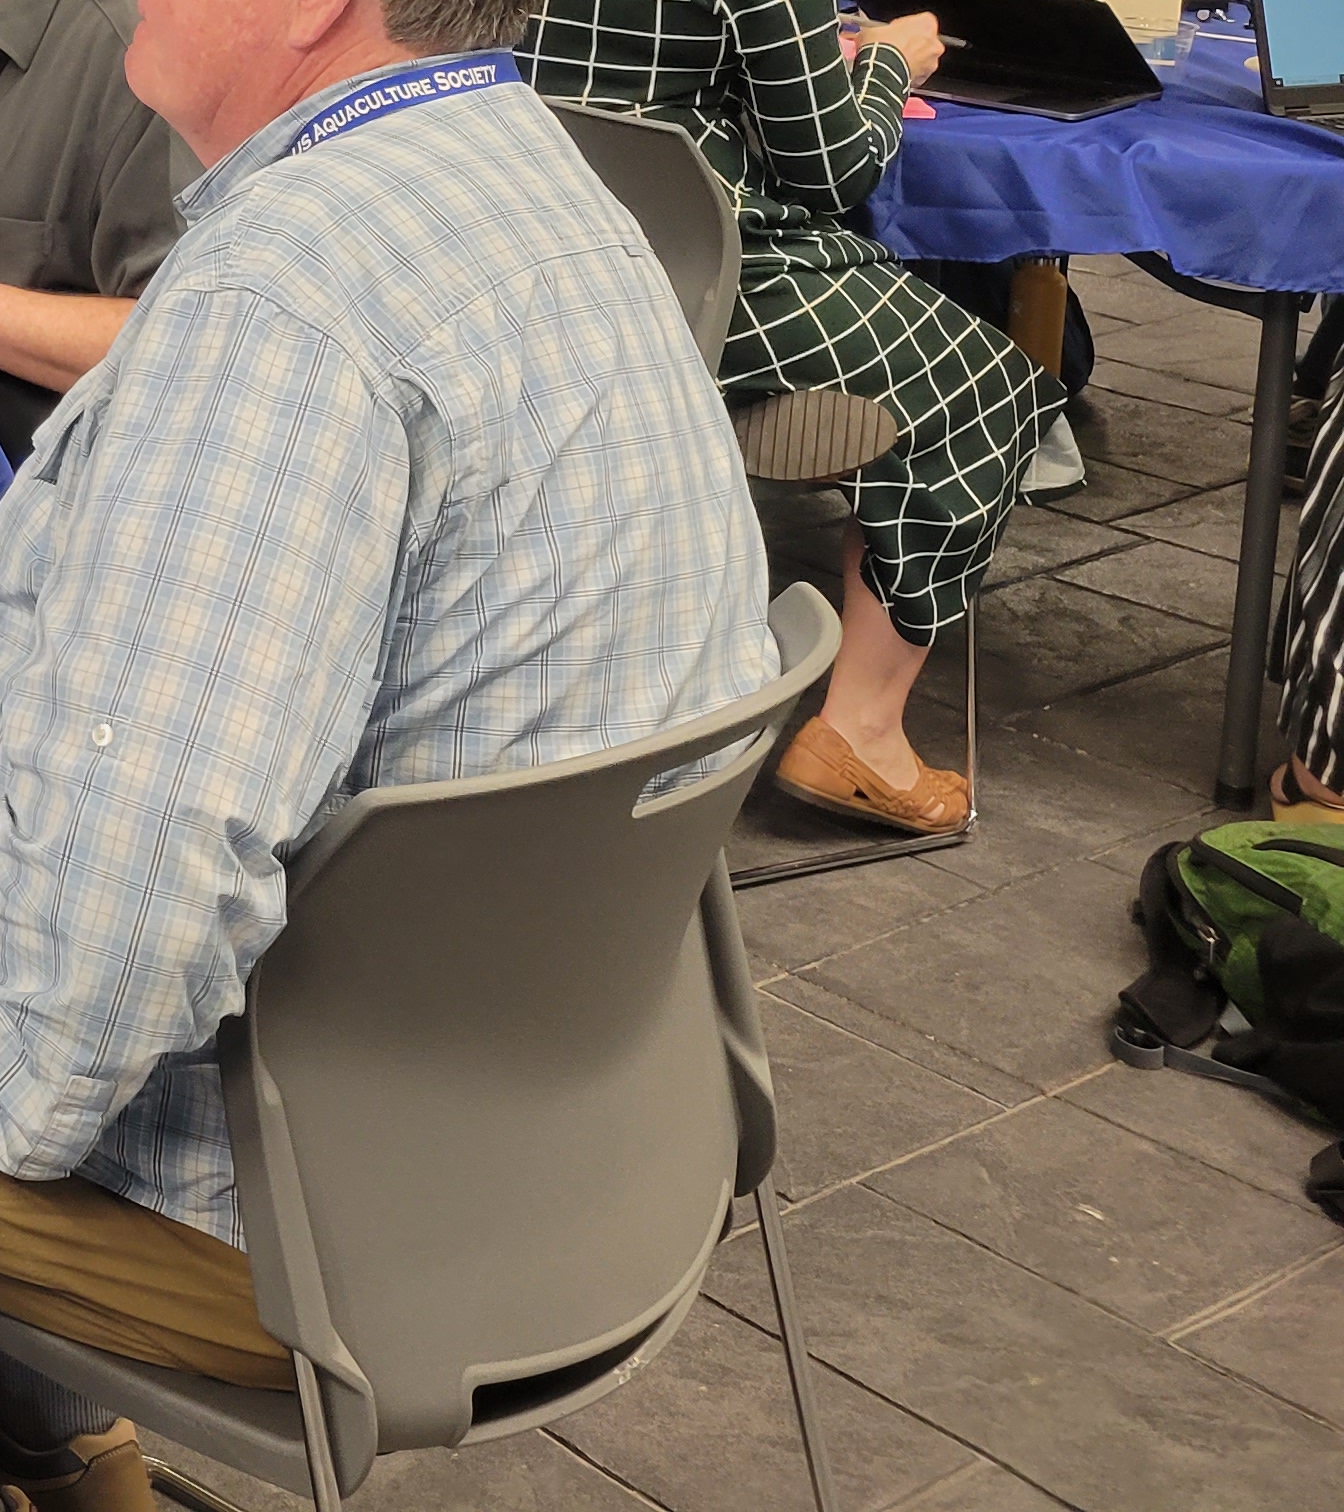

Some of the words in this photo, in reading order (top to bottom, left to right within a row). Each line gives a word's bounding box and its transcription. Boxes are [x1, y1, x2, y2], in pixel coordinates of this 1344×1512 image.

[292, 131, 312, 157] US
[313, 78, 437, 141] AQUACULTURE
[437, 64, 498, 91] SOCIETY
